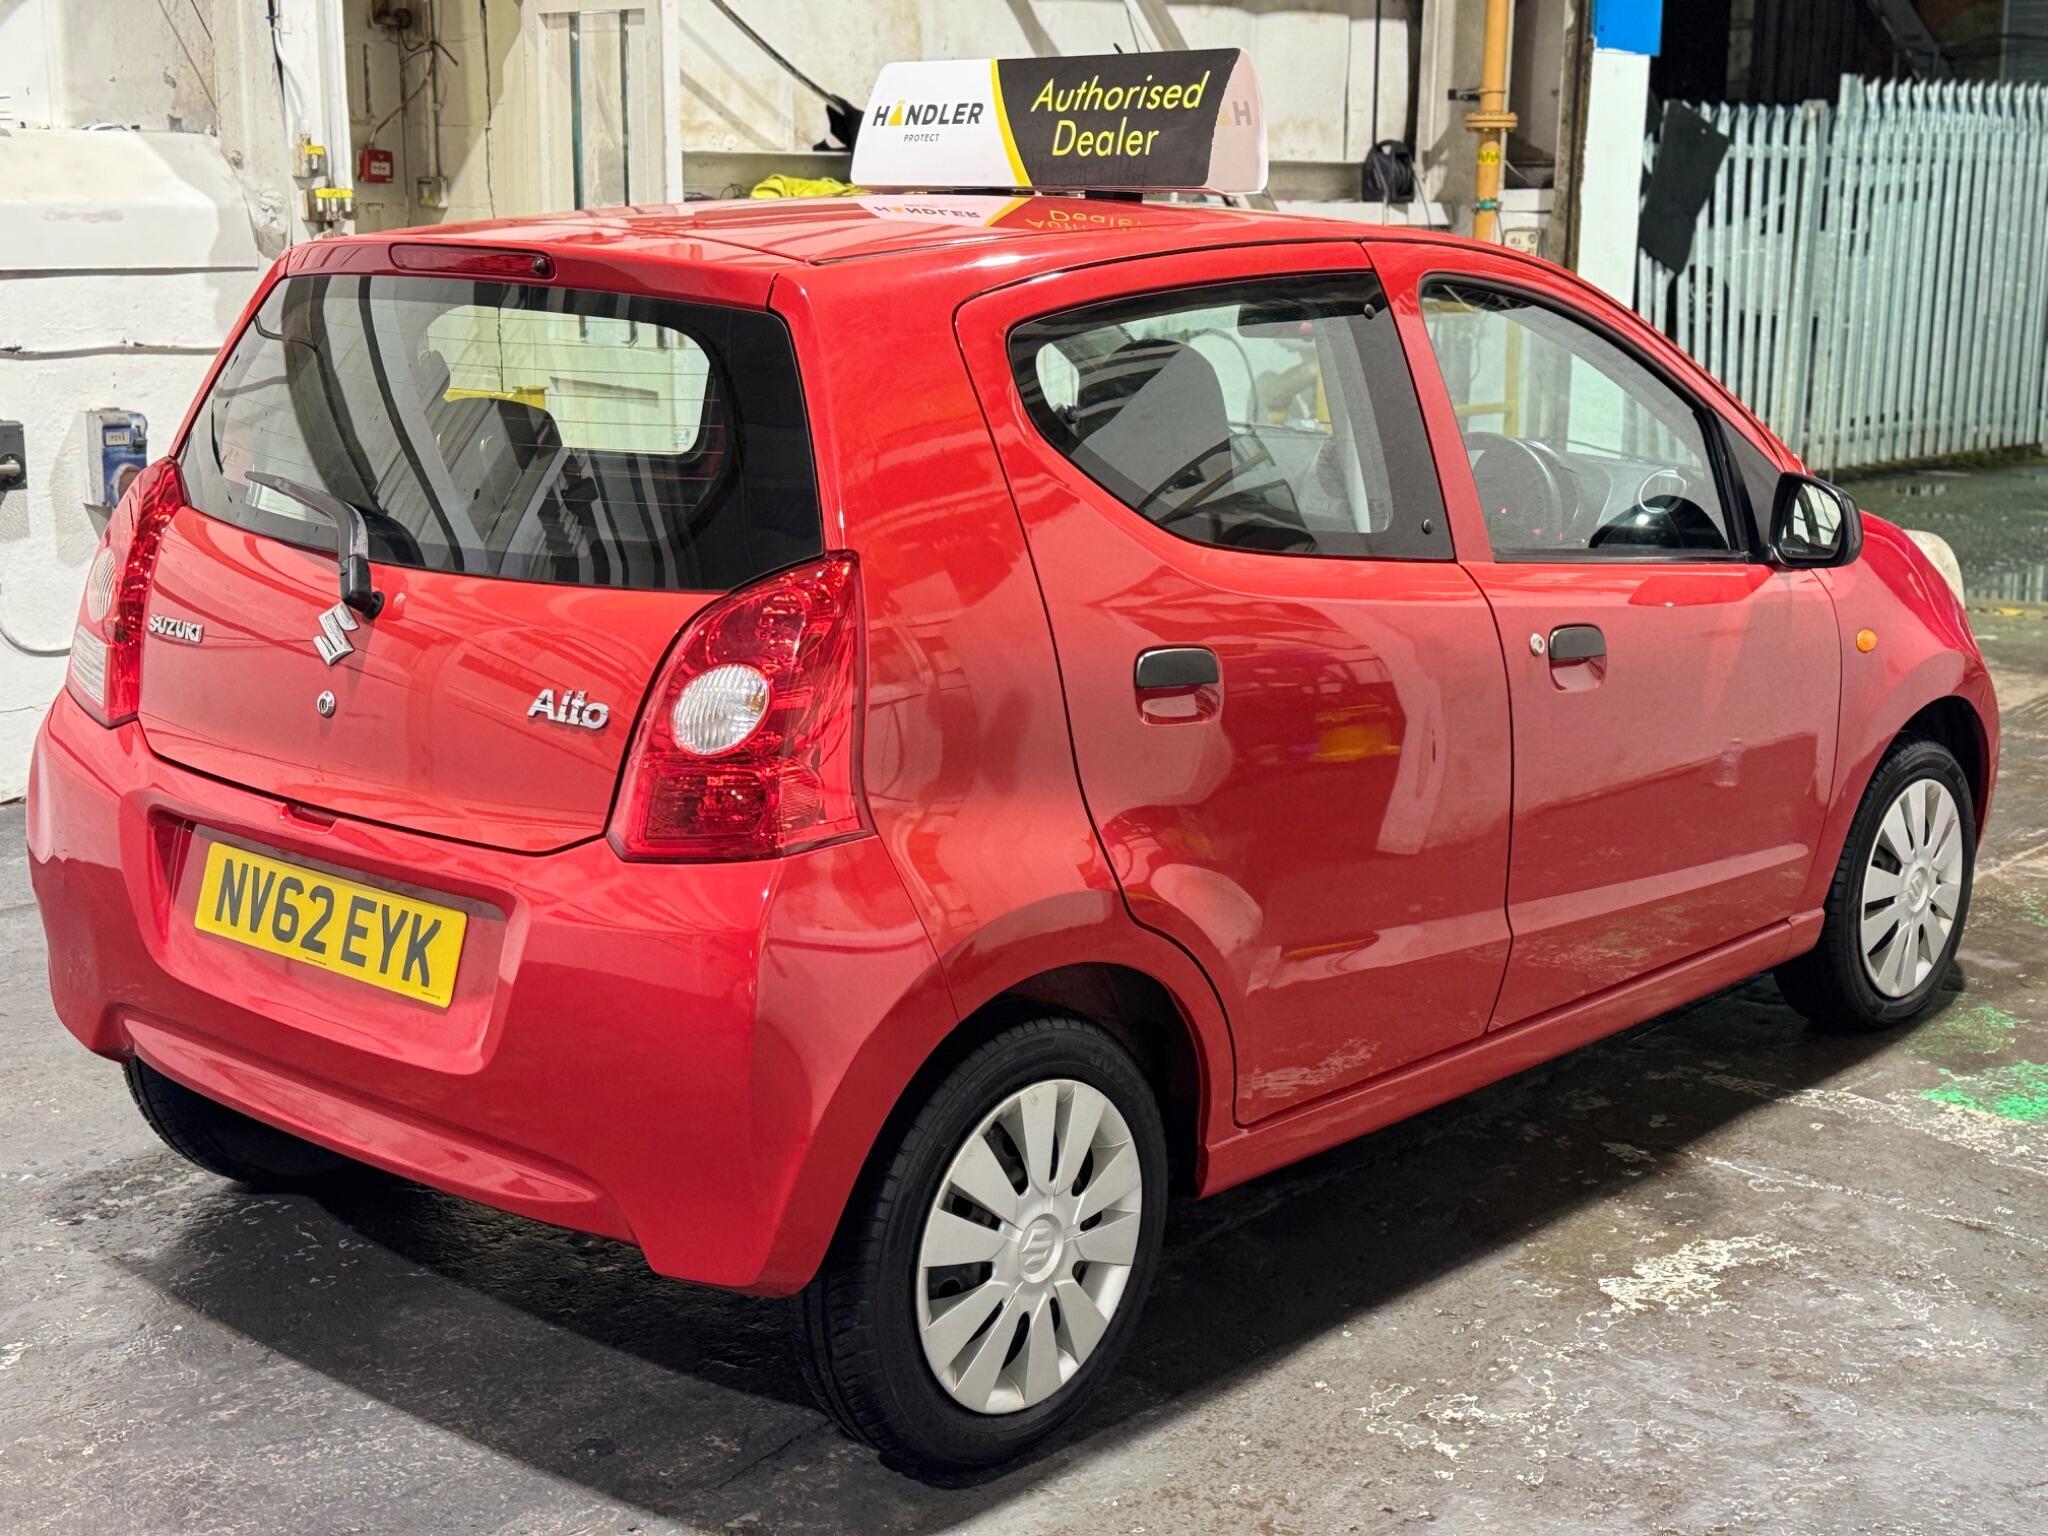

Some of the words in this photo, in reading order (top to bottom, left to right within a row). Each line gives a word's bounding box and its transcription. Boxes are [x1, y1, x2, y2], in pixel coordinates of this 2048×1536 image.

[1030, 70, 1211, 113] Authorised
[903, 133, 941, 143] PROTECT
[1051, 116, 1160, 157] Dealer
[149, 614, 204, 644] SUZUKI
[527, 687, 610, 730] Alto
[214, 858, 335, 955] NV62
[340, 895, 442, 988] EYK
